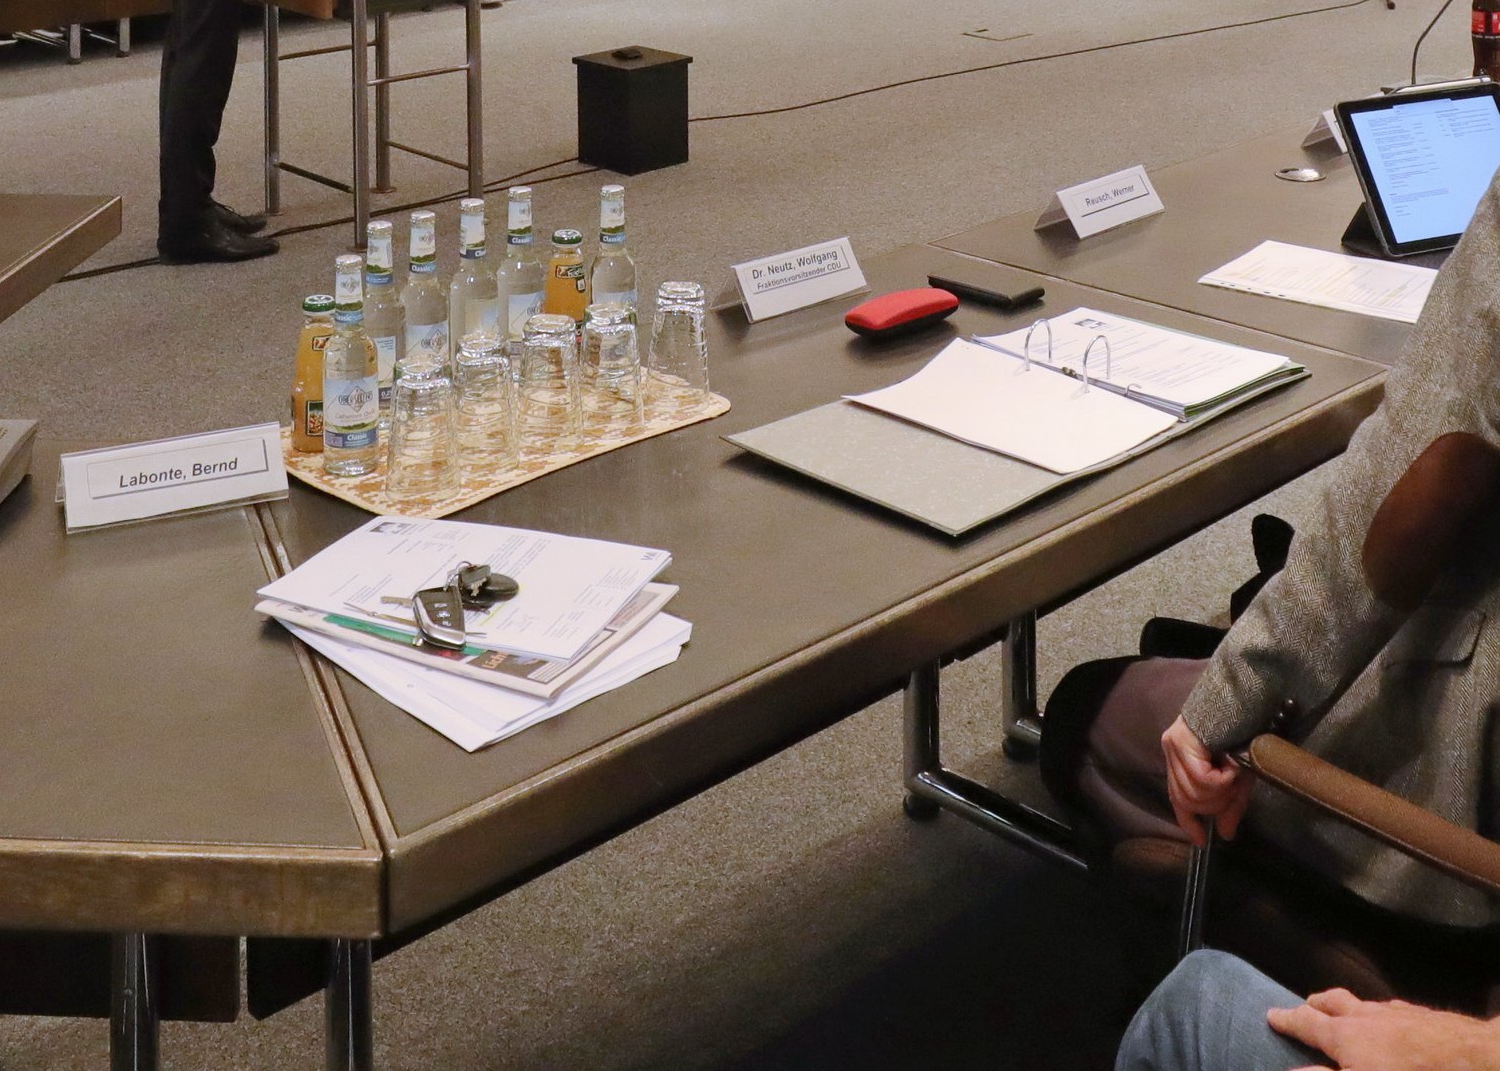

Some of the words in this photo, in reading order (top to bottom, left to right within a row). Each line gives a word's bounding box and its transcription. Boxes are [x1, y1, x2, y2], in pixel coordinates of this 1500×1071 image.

[1112, 184, 1135, 198] Werner
[752, 268, 767, 279] Dr.
[767, 260, 796, 276] Neutz,
[796, 249, 838, 268] Wolfgang
[757, 267, 827, 290] Fraktionsvorsitzender
[827, 261, 842, 272] CDU
[347, 432, 368, 440] Classic
[119, 467, 187, 489] Labonte,
[192, 457, 239, 477] Bernd
